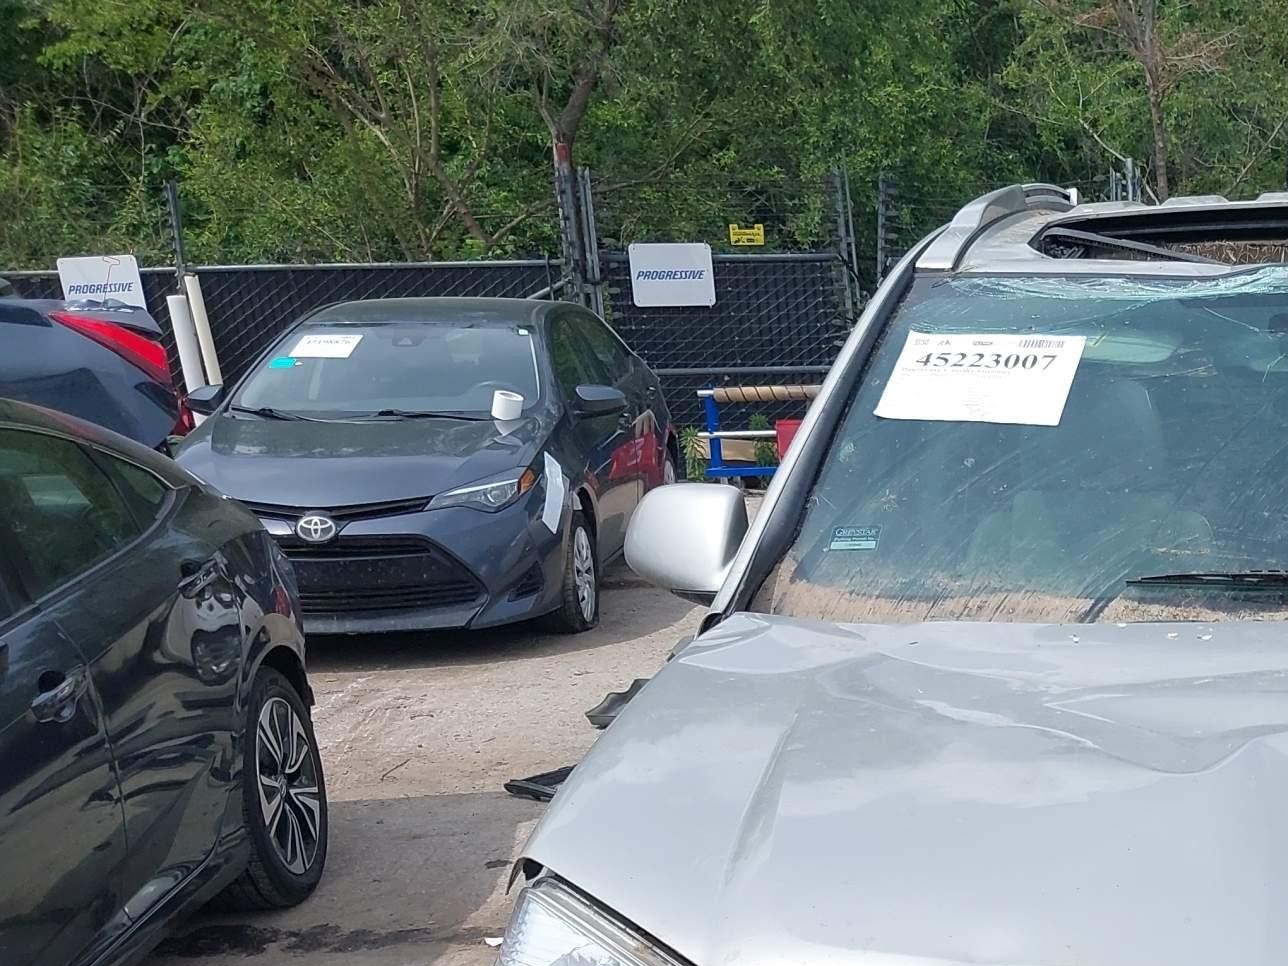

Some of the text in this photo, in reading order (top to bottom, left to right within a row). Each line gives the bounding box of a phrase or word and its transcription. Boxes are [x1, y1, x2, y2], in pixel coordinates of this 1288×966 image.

[636, 270, 705, 280] PROGRESSIVE
[69, 283, 134, 294] PROGRESSIVE
[915, 352, 1058, 371] 45223007
